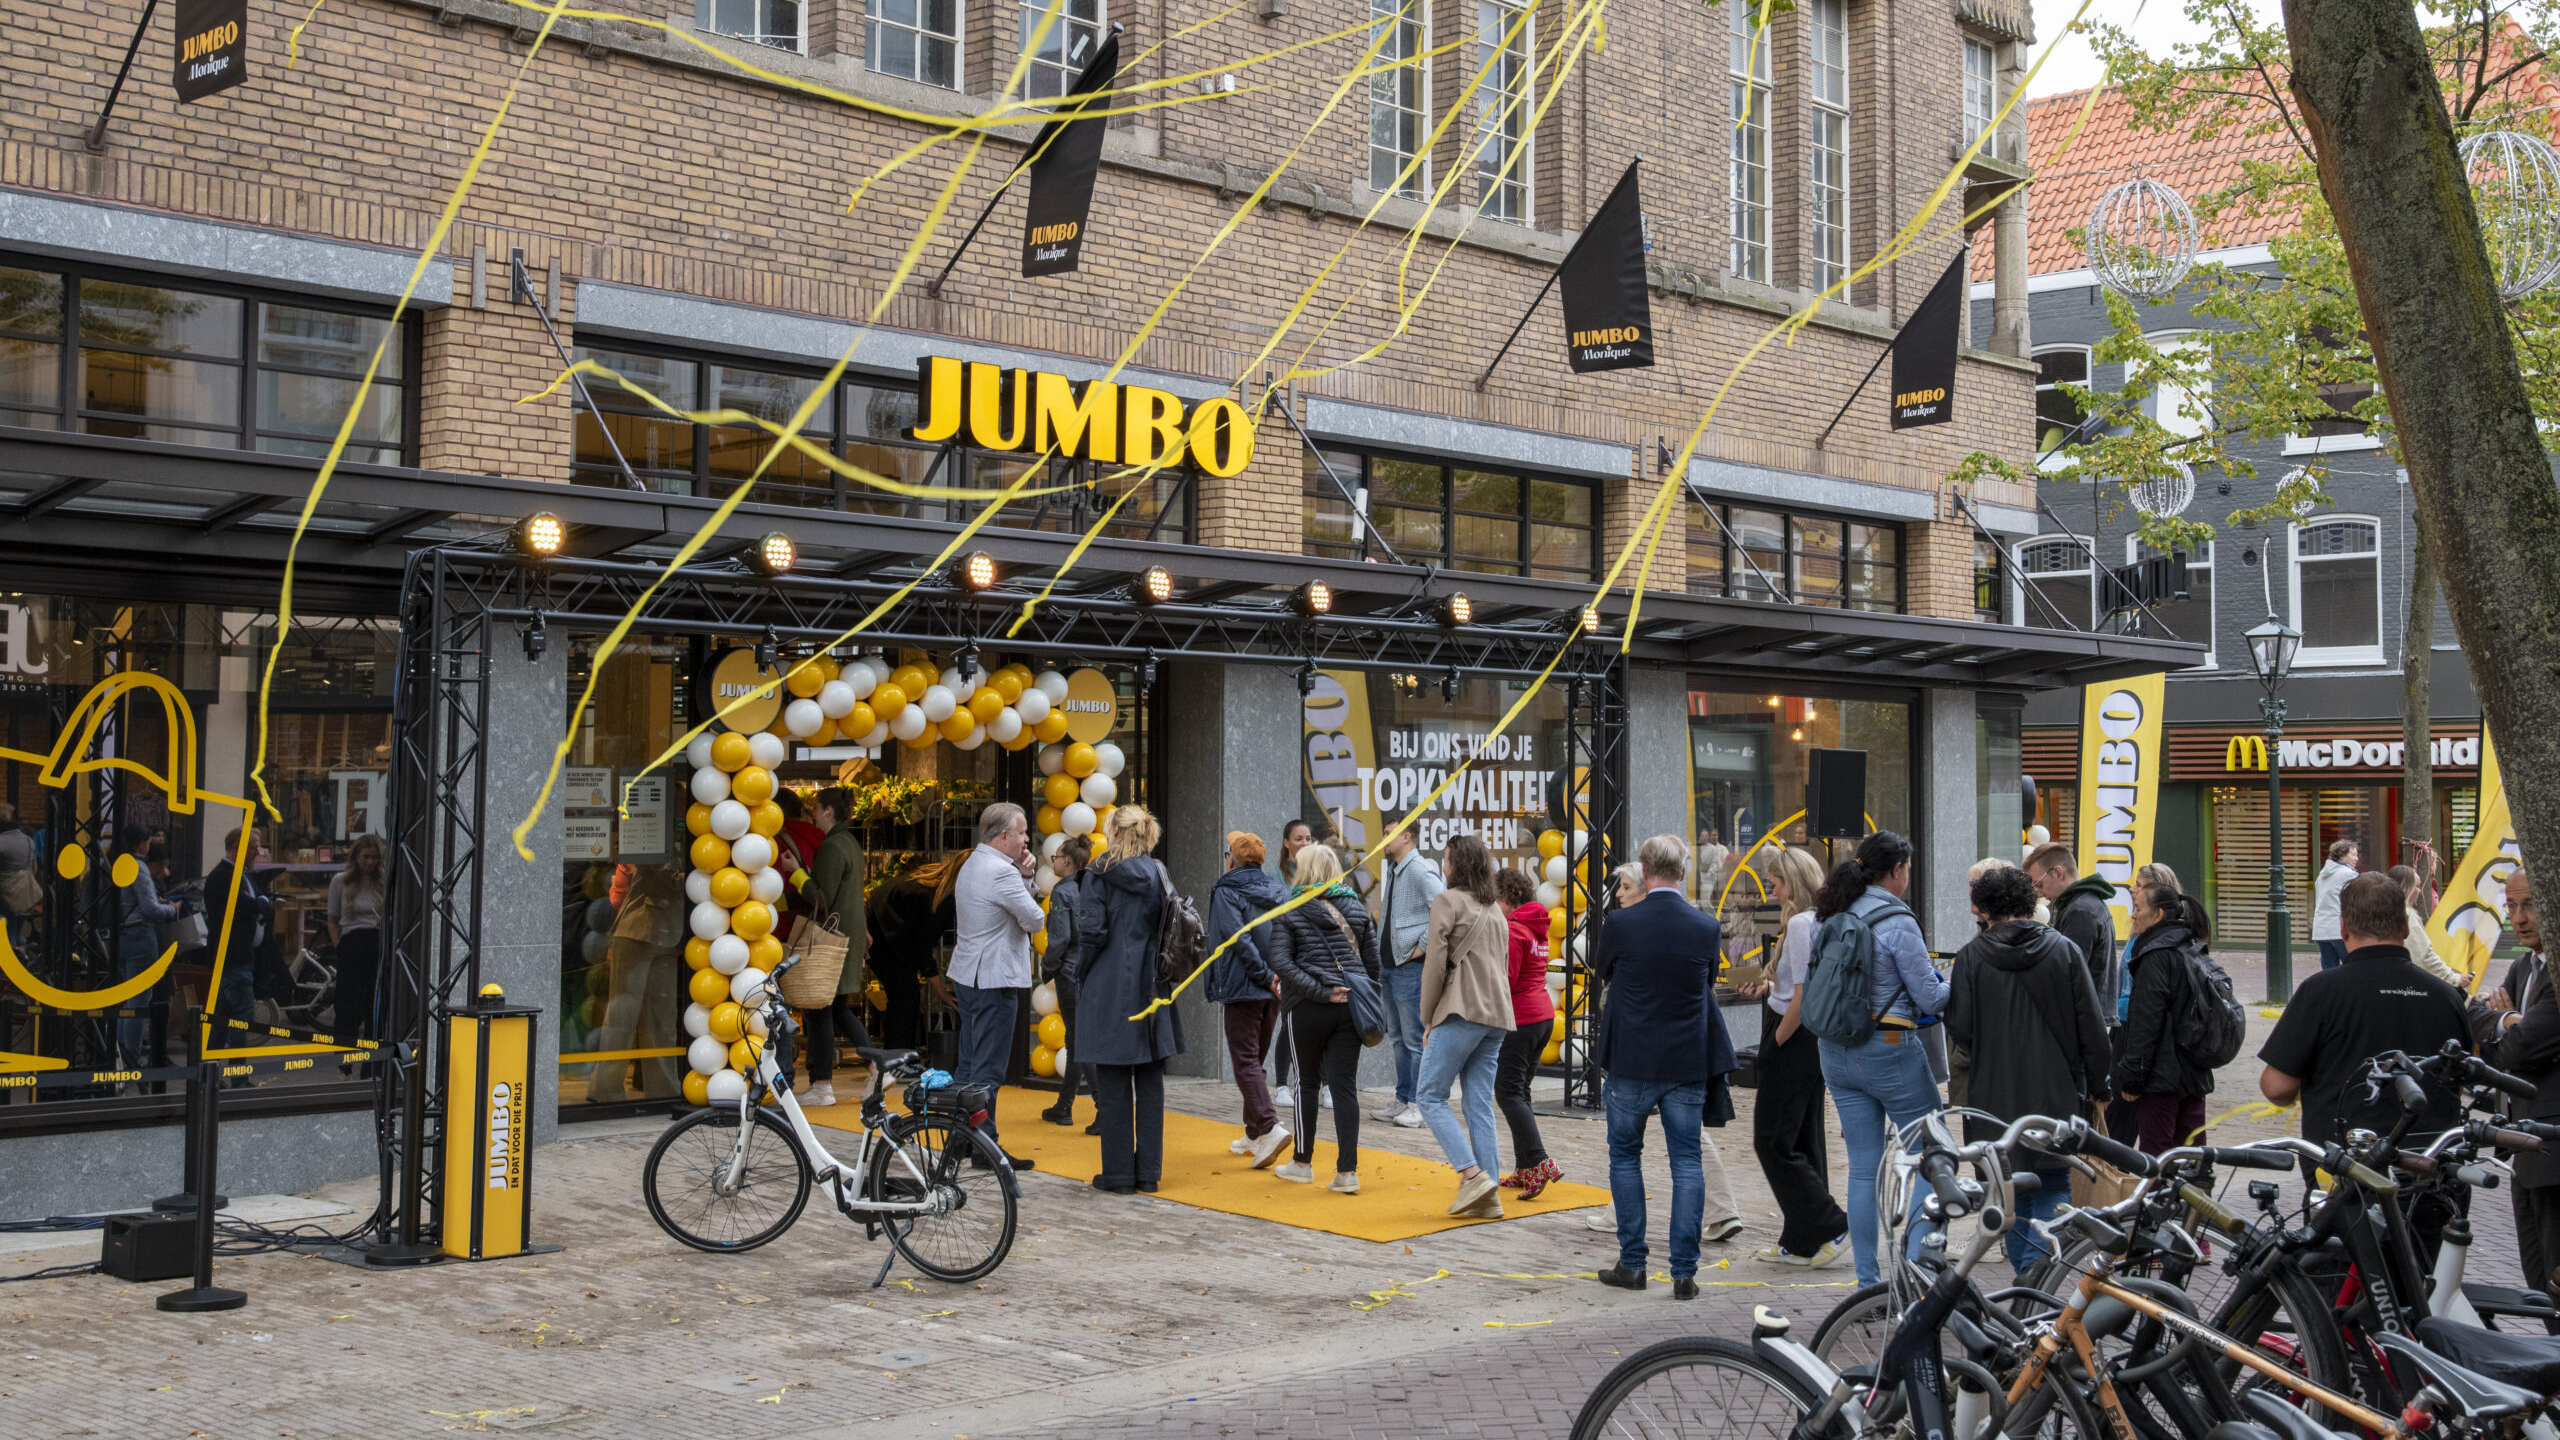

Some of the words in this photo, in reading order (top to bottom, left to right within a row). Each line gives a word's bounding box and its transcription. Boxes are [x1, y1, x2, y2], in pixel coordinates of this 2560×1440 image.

[181, 21, 238, 63] JUMBO
[188, 54, 229, 81] Monique
[1029, 222, 1078, 245] JUMBO
[1035, 243, 1067, 261] Monique
[1572, 326, 1640, 347] JUMBO
[1582, 345, 1631, 360] Monique
[1895, 388, 1945, 408] JUMBO
[914, 356, 1255, 478] JUMBO
[1901, 404, 1936, 418] Monique
[1065, 699, 1110, 714] JUMBO
[1390, 731, 1418, 758] BIJ
[1424, 732, 1461, 760] ONS
[1467, 733, 1510, 760] VIND
[1513, 735, 1532, 761] JE
[2096, 689, 2143, 916] JUMBO
[1481, 818, 1517, 850] EEN
[228, 1018, 249, 1031] JUMBO
[269, 1026, 290, 1038] JUMBO
[312, 1033, 334, 1045] JUMBO
[356, 1038, 379, 1050] JUMBO
[284, 1058, 313, 1071] JUMBO
[342, 1051, 371, 1064] JUMBO
[91, 1071, 142, 1083] JUMBO
[223, 1065, 253, 1078] JUMBO
[513, 1081, 522, 1107] PRIJS
[513, 1109, 521, 1124] DIE
[489, 1082, 511, 1191] JUMBO
[512, 1126, 520, 1154] VOOR
[511, 1157, 519, 1175] DAT
[511, 1176, 519, 1188] EN
